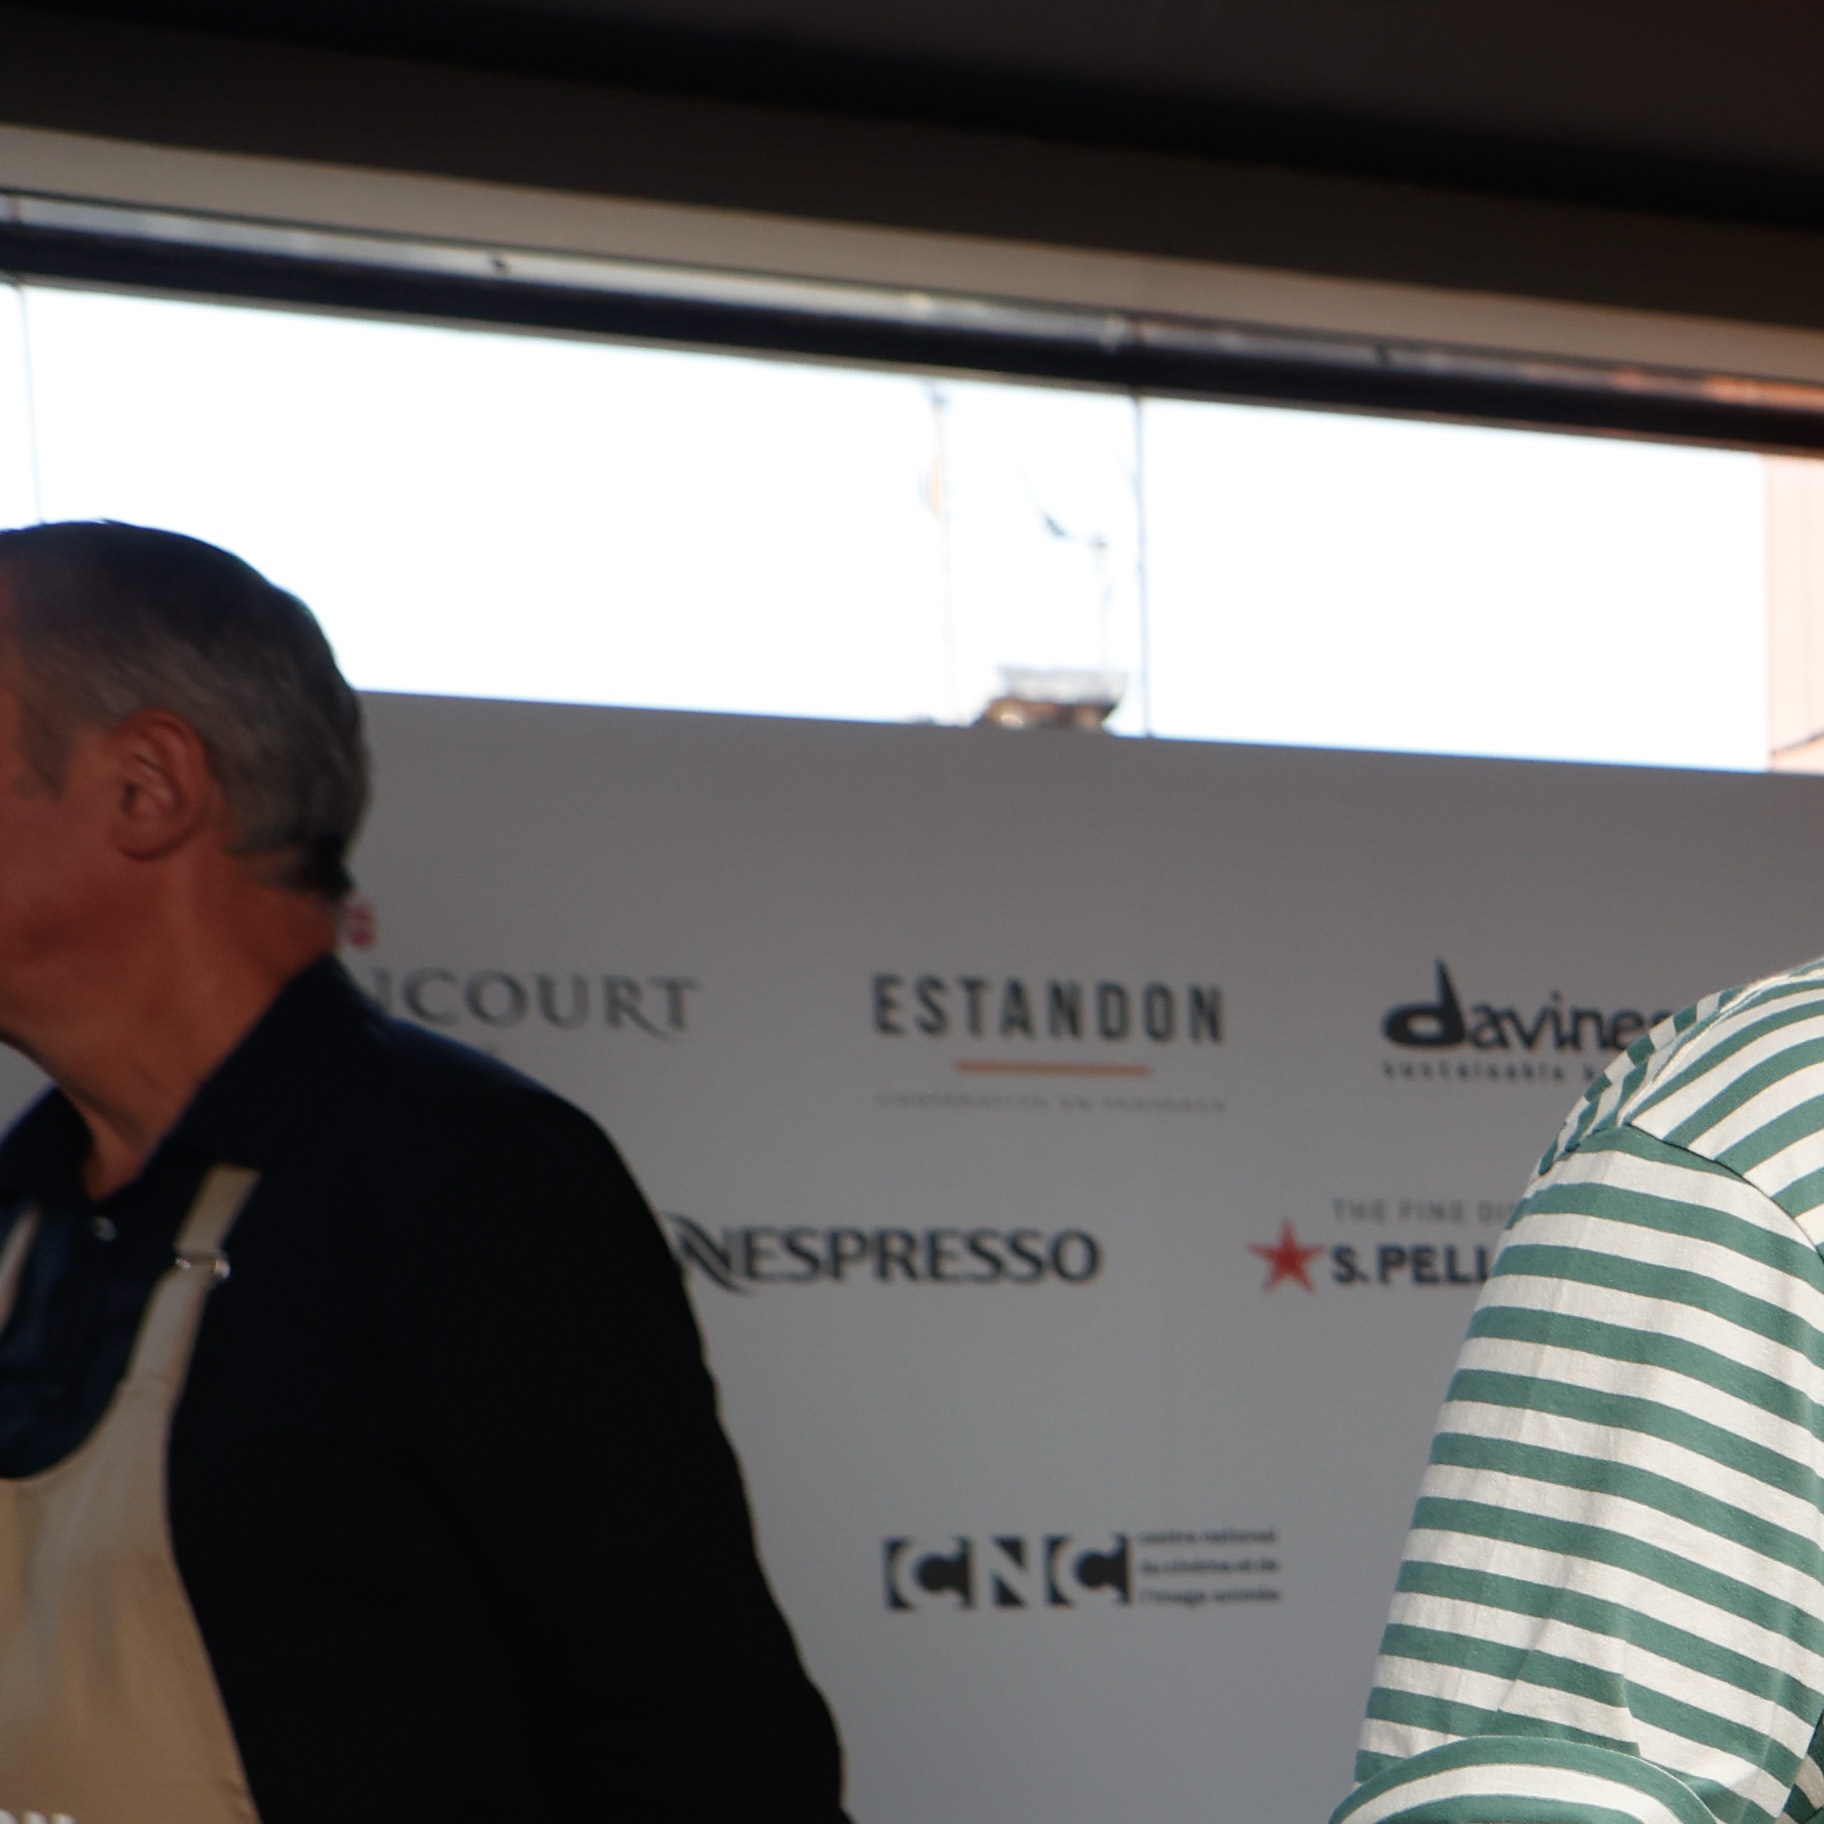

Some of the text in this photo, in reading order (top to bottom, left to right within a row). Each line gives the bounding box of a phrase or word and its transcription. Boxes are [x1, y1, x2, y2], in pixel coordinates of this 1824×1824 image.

[872, 972, 1225, 1043] ESTANDON
[662, 1208, 1103, 1297] NESPRESSO
[883, 1534, 1132, 1611] CNC
